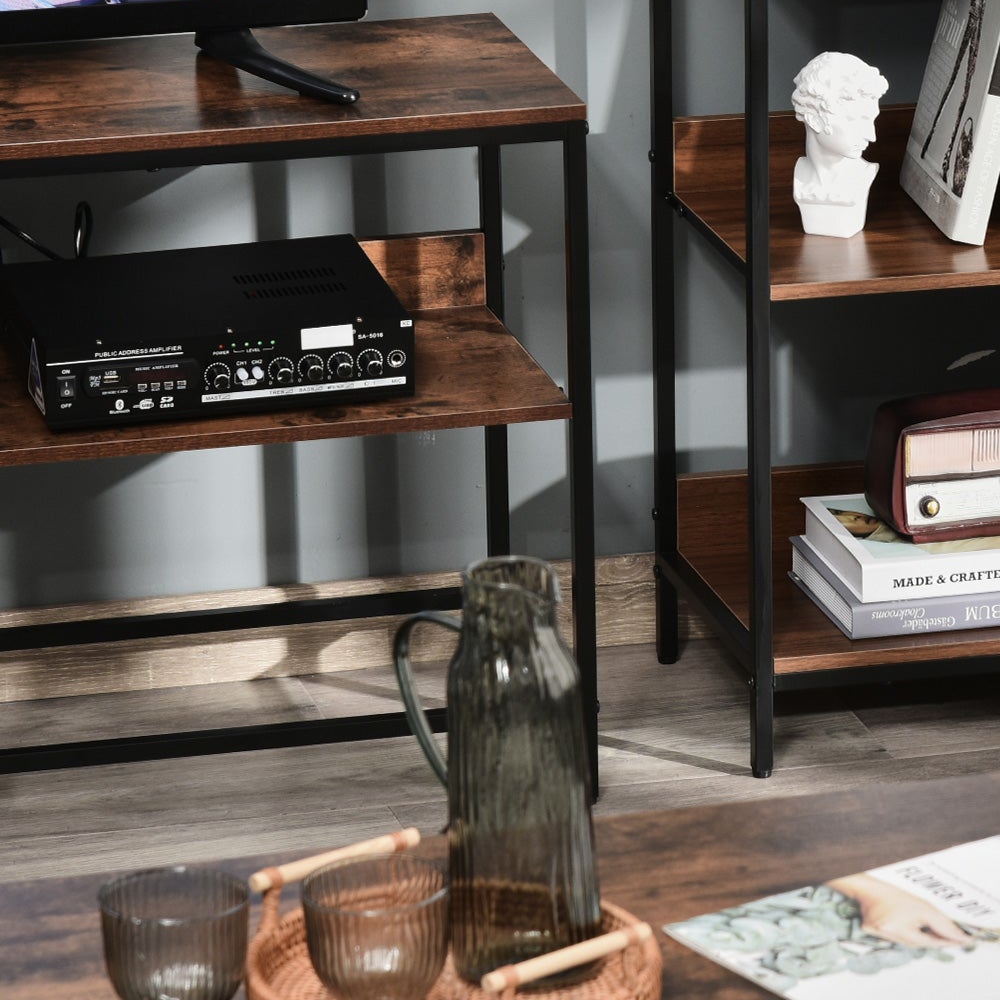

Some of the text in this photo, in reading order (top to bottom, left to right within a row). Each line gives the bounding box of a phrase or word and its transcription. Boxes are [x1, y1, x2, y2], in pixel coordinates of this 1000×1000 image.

[95, 345, 183, 358] PUBLIC ADDRESS AMPLIFIER
[892, 576, 933, 589] MADE
[936, 574, 946, 585] &
[871, 606, 927, 620] Cloakrooms
[902, 616, 956, 631] Gästebäder
